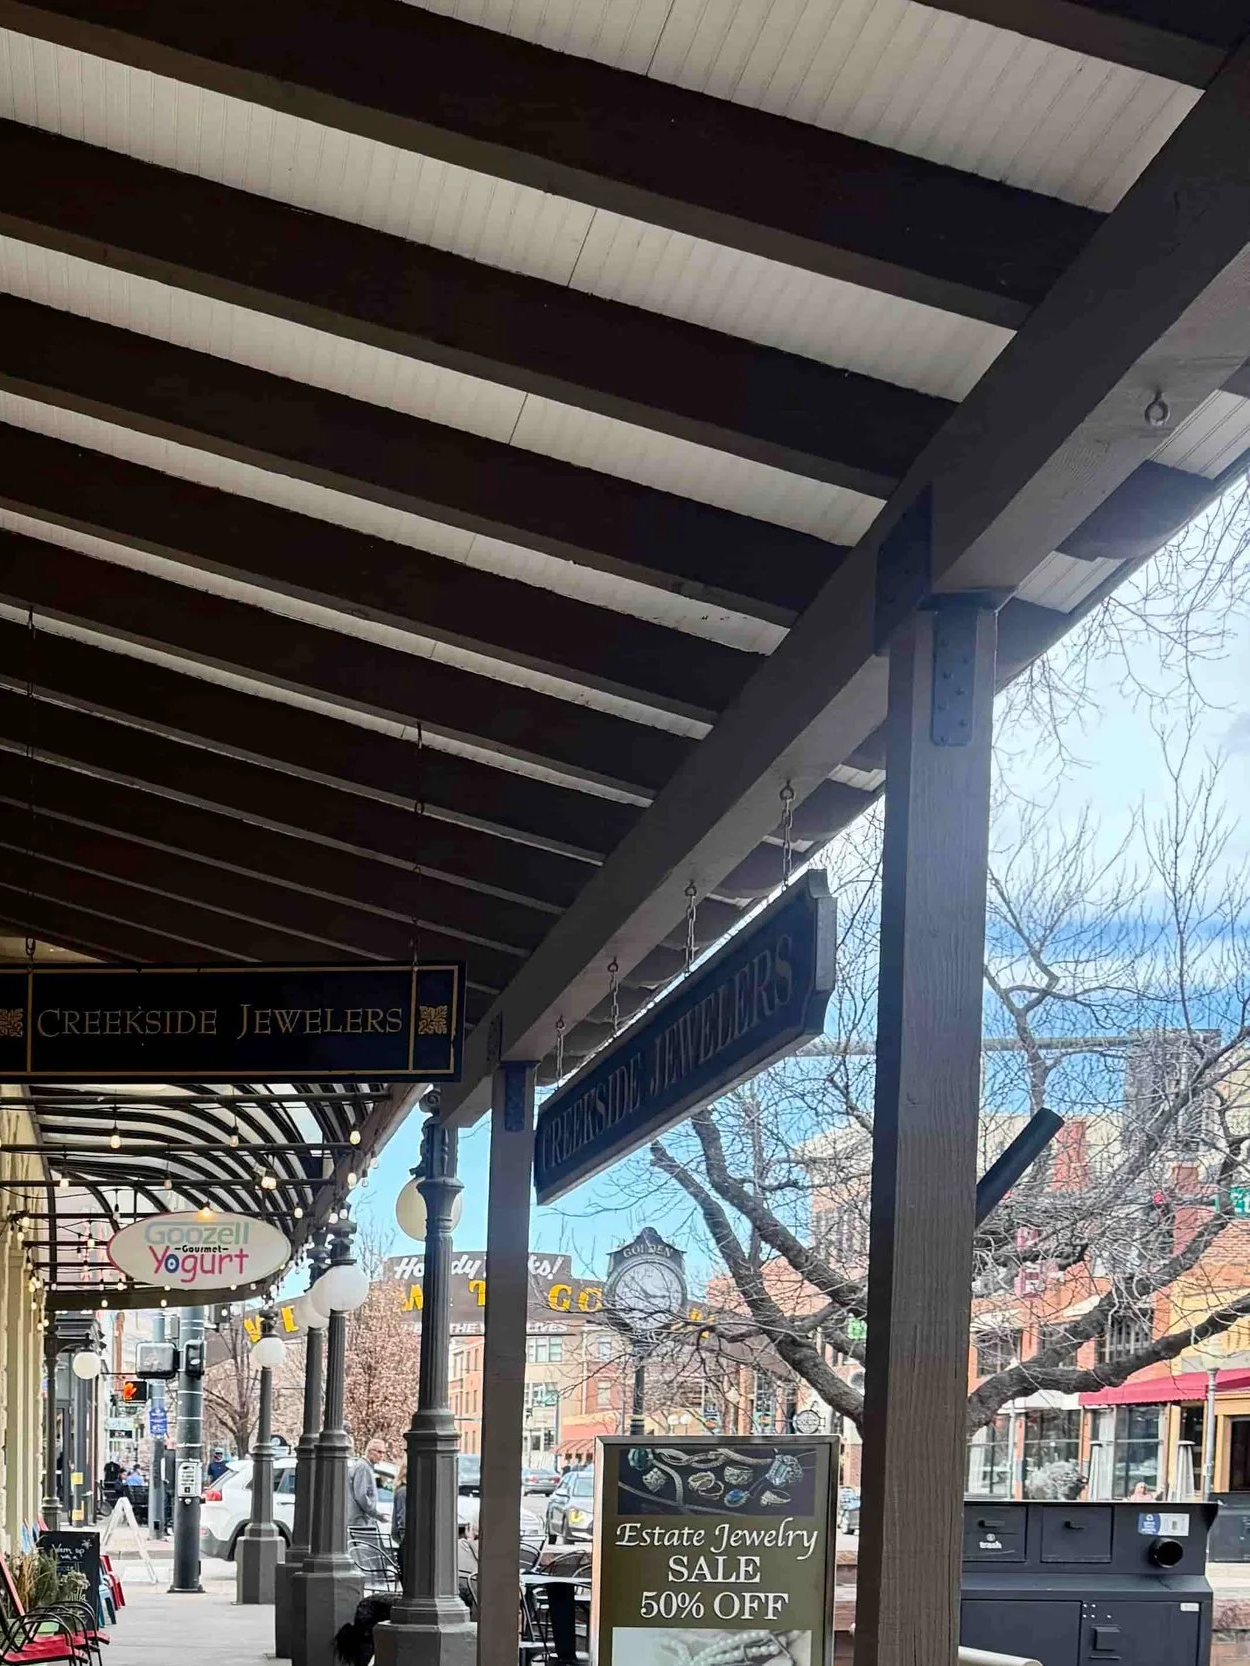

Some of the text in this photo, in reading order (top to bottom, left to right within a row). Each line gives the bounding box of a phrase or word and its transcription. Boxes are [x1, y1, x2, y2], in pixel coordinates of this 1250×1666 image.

[36, 1003, 404, 1041] CREEKSIDE JEWELERS
[651, 934, 794, 1097] JEWELERS
[144, 1221, 250, 1245] Goozell
[181, 1244, 223, 1254] Gourmet
[623, 1244, 672, 1258] GOLDEN
[148, 1245, 249, 1284] Yogurt
[394, 1255, 481, 1280] Hody
[615, 1517, 819, 1561] Estate Jewelry
[668, 1555, 761, 1583] SALE
[640, 1591, 789, 1620] 50% OFF
